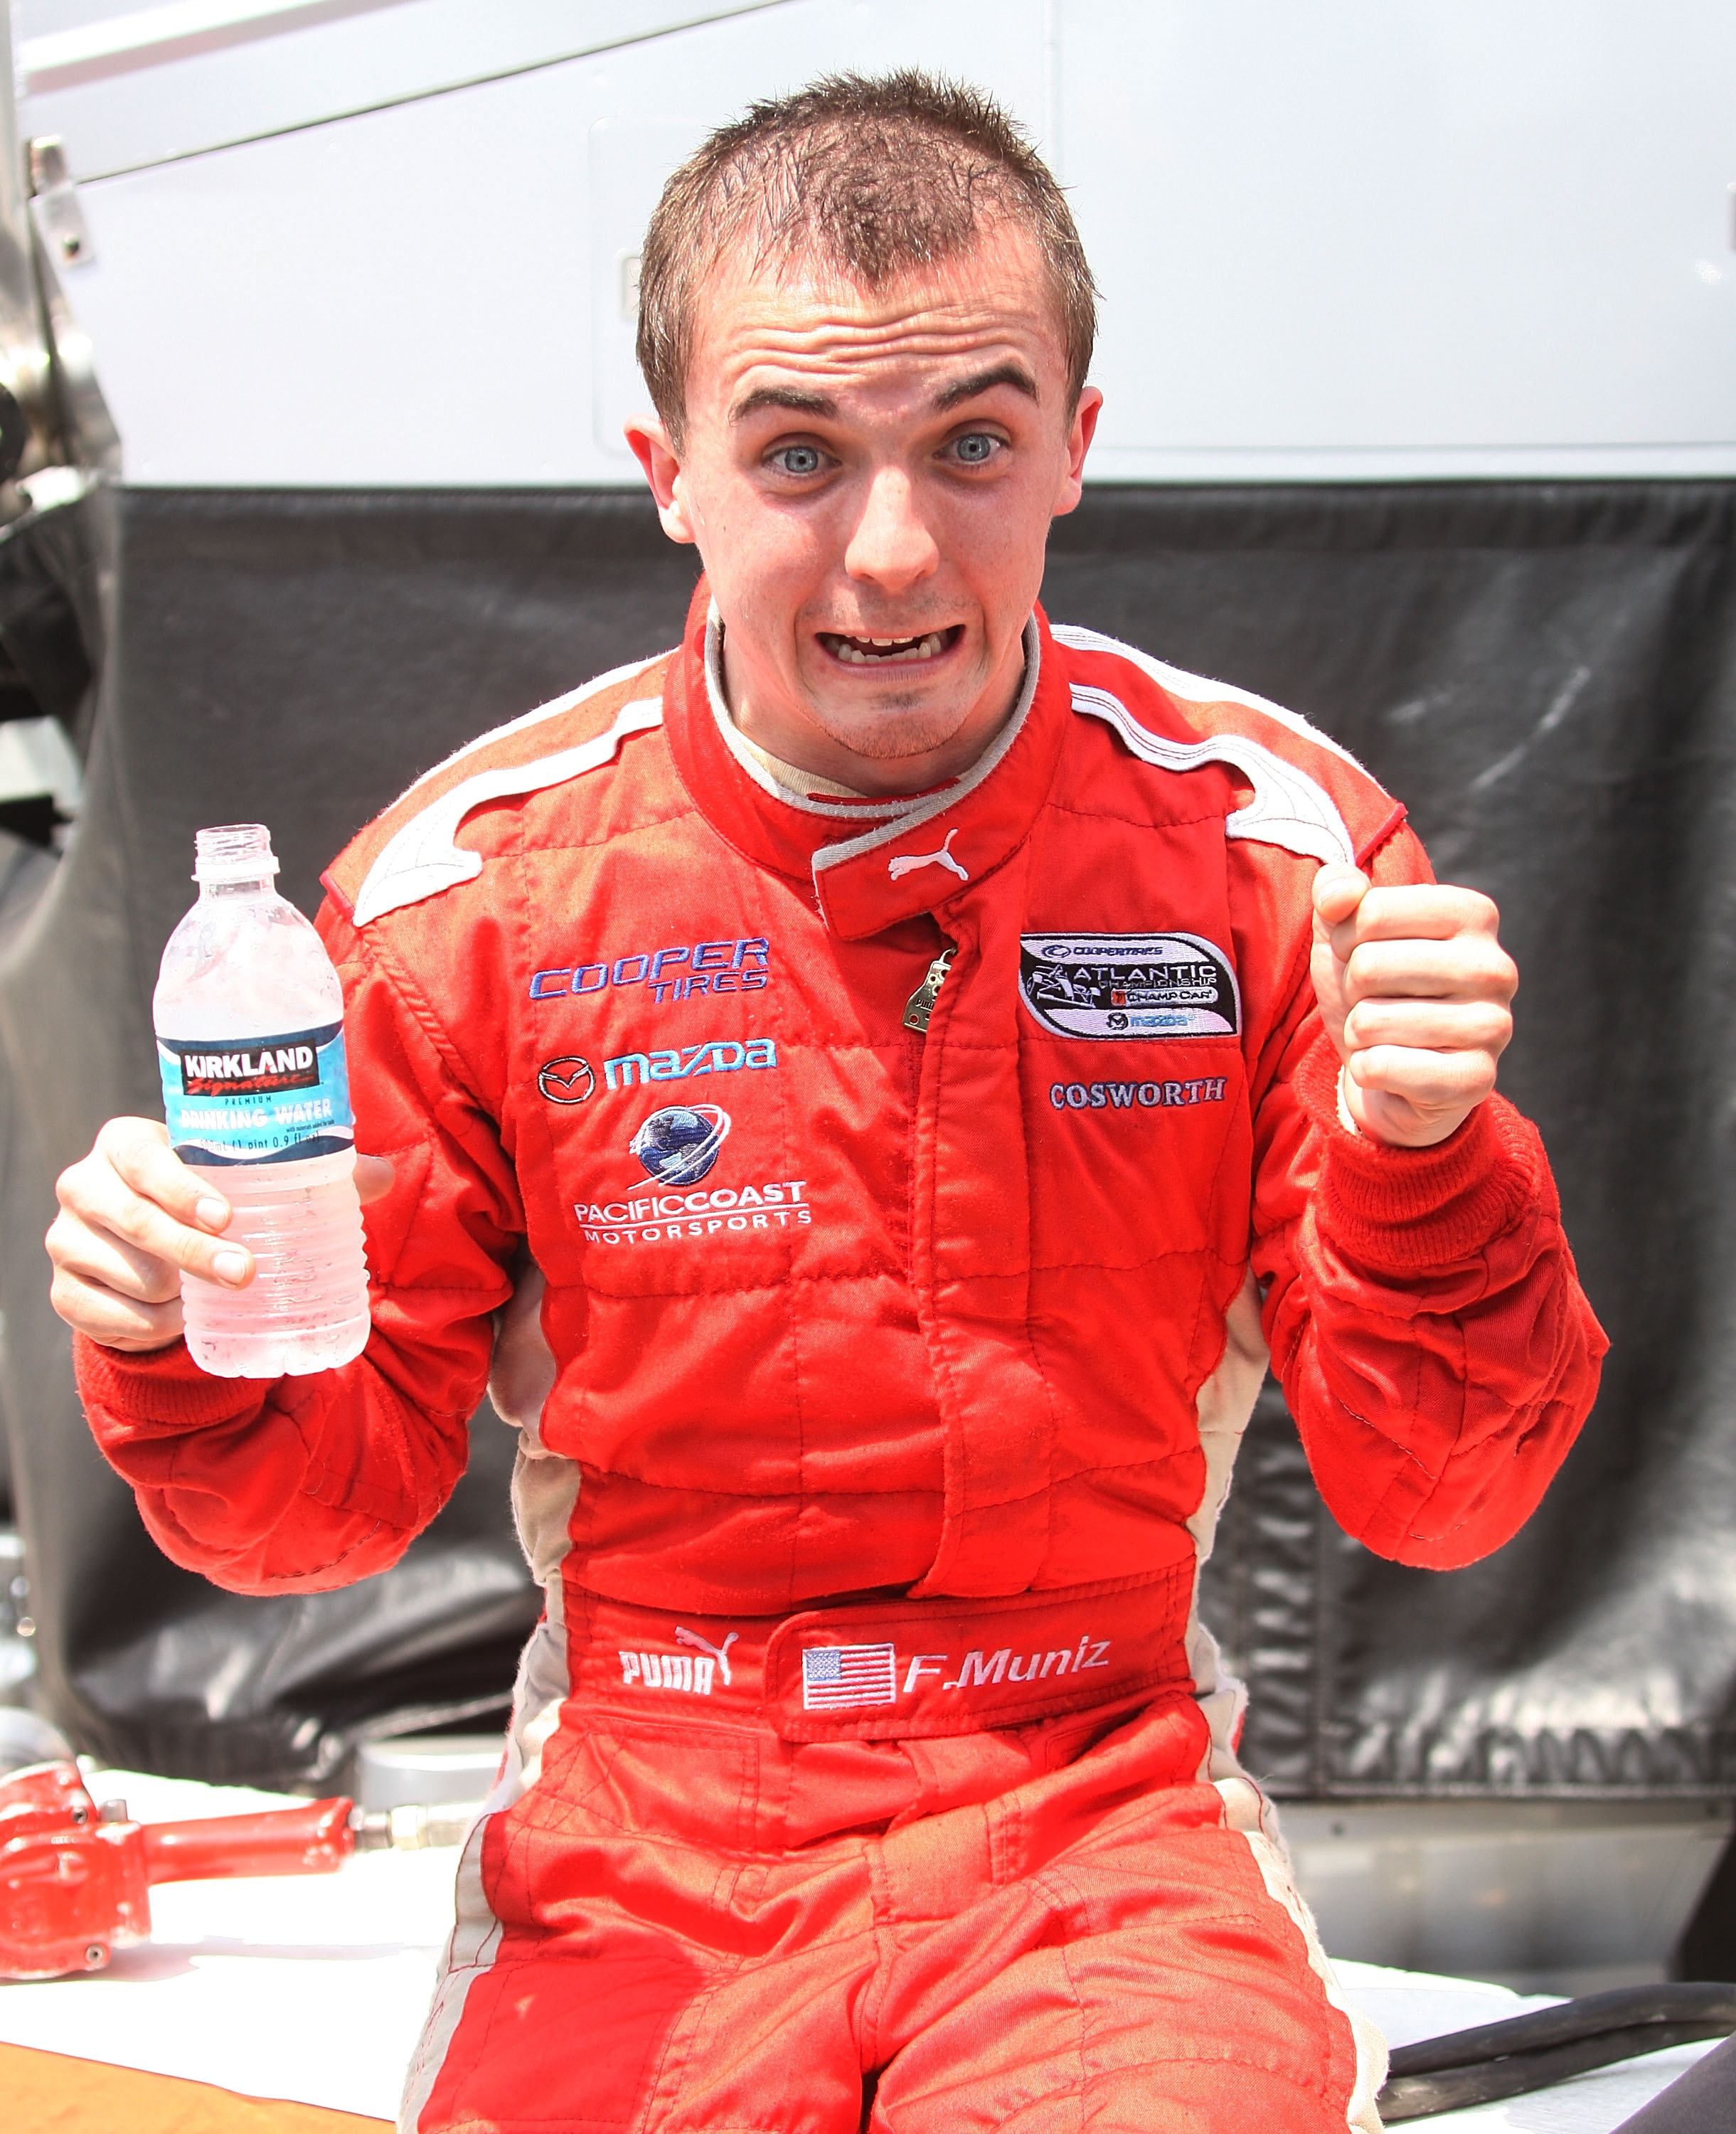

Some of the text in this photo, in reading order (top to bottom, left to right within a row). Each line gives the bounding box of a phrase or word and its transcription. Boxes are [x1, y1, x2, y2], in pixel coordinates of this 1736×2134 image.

[529, 937, 770, 999] COOPER
[1073, 965, 1217, 981] ATLANTIC
[1098, 977, 1217, 989] CHAMPIONSHIP
[649, 969, 768, 1004] TIRES
[915, 998, 935, 1012] PUM
[184, 1046, 314, 1078] KIRKLAND
[603, 1038, 777, 1089] mazda
[225, 1095, 272, 1106] PREMIUM
[1049, 1076, 1228, 1110] COSWORTH
[180, 1098, 332, 1130] DRINKING WATER
[248, 1140, 268, 1150] pint
[272, 1135, 289, 1148] 0.9
[584, 1210, 812, 1245] MOTORSPORTS
[618, 1651, 714, 1696] PUMA
[902, 1635, 1110, 1693] F.Muniz
